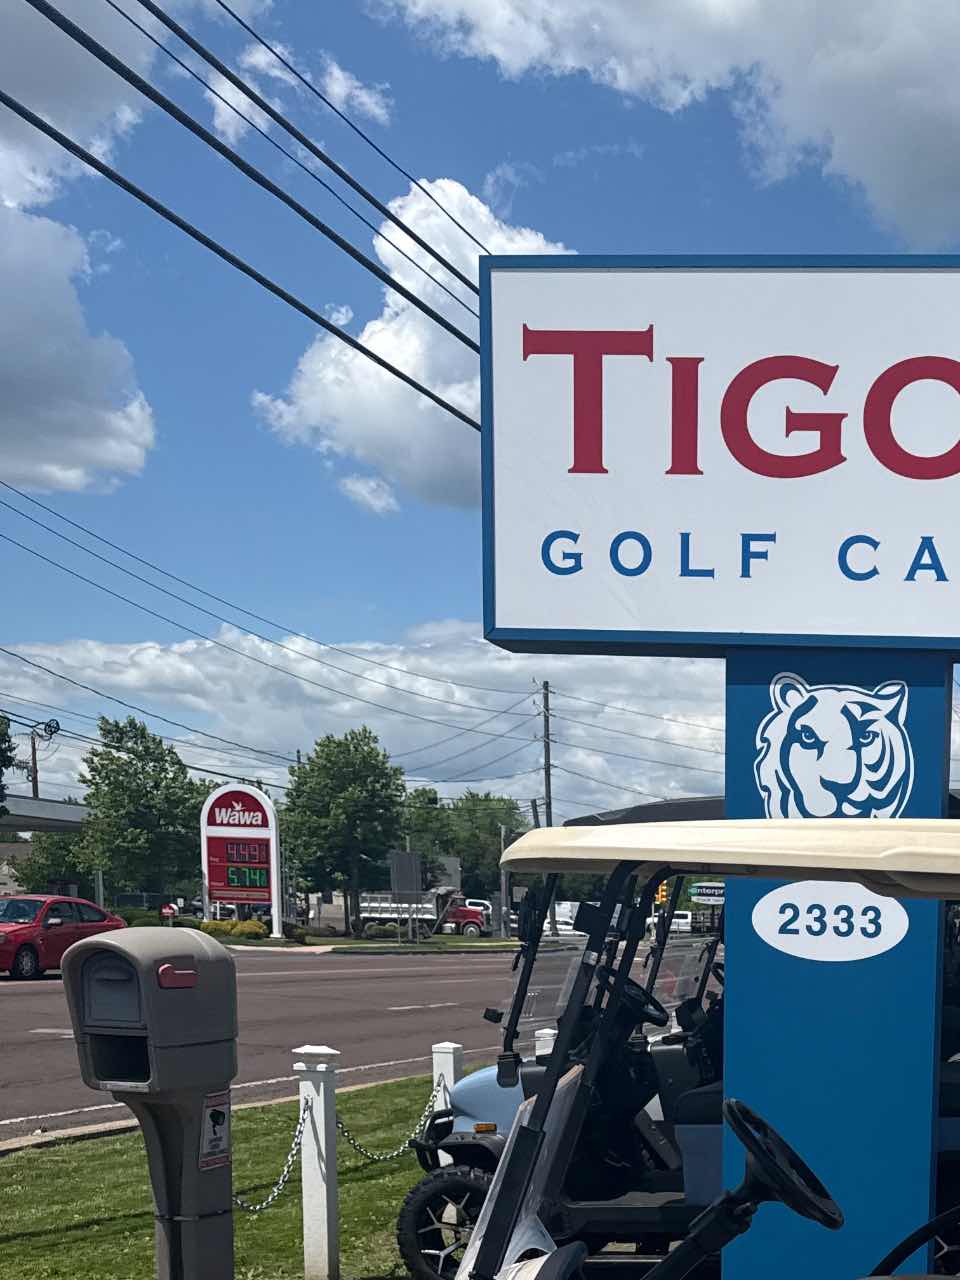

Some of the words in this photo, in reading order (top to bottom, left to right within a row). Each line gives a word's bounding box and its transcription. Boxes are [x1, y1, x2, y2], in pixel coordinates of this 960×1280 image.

[541, 529, 777, 578] GOLF
[214, 807, 262, 825] Wawa
[777, 902, 882, 939] 2333
